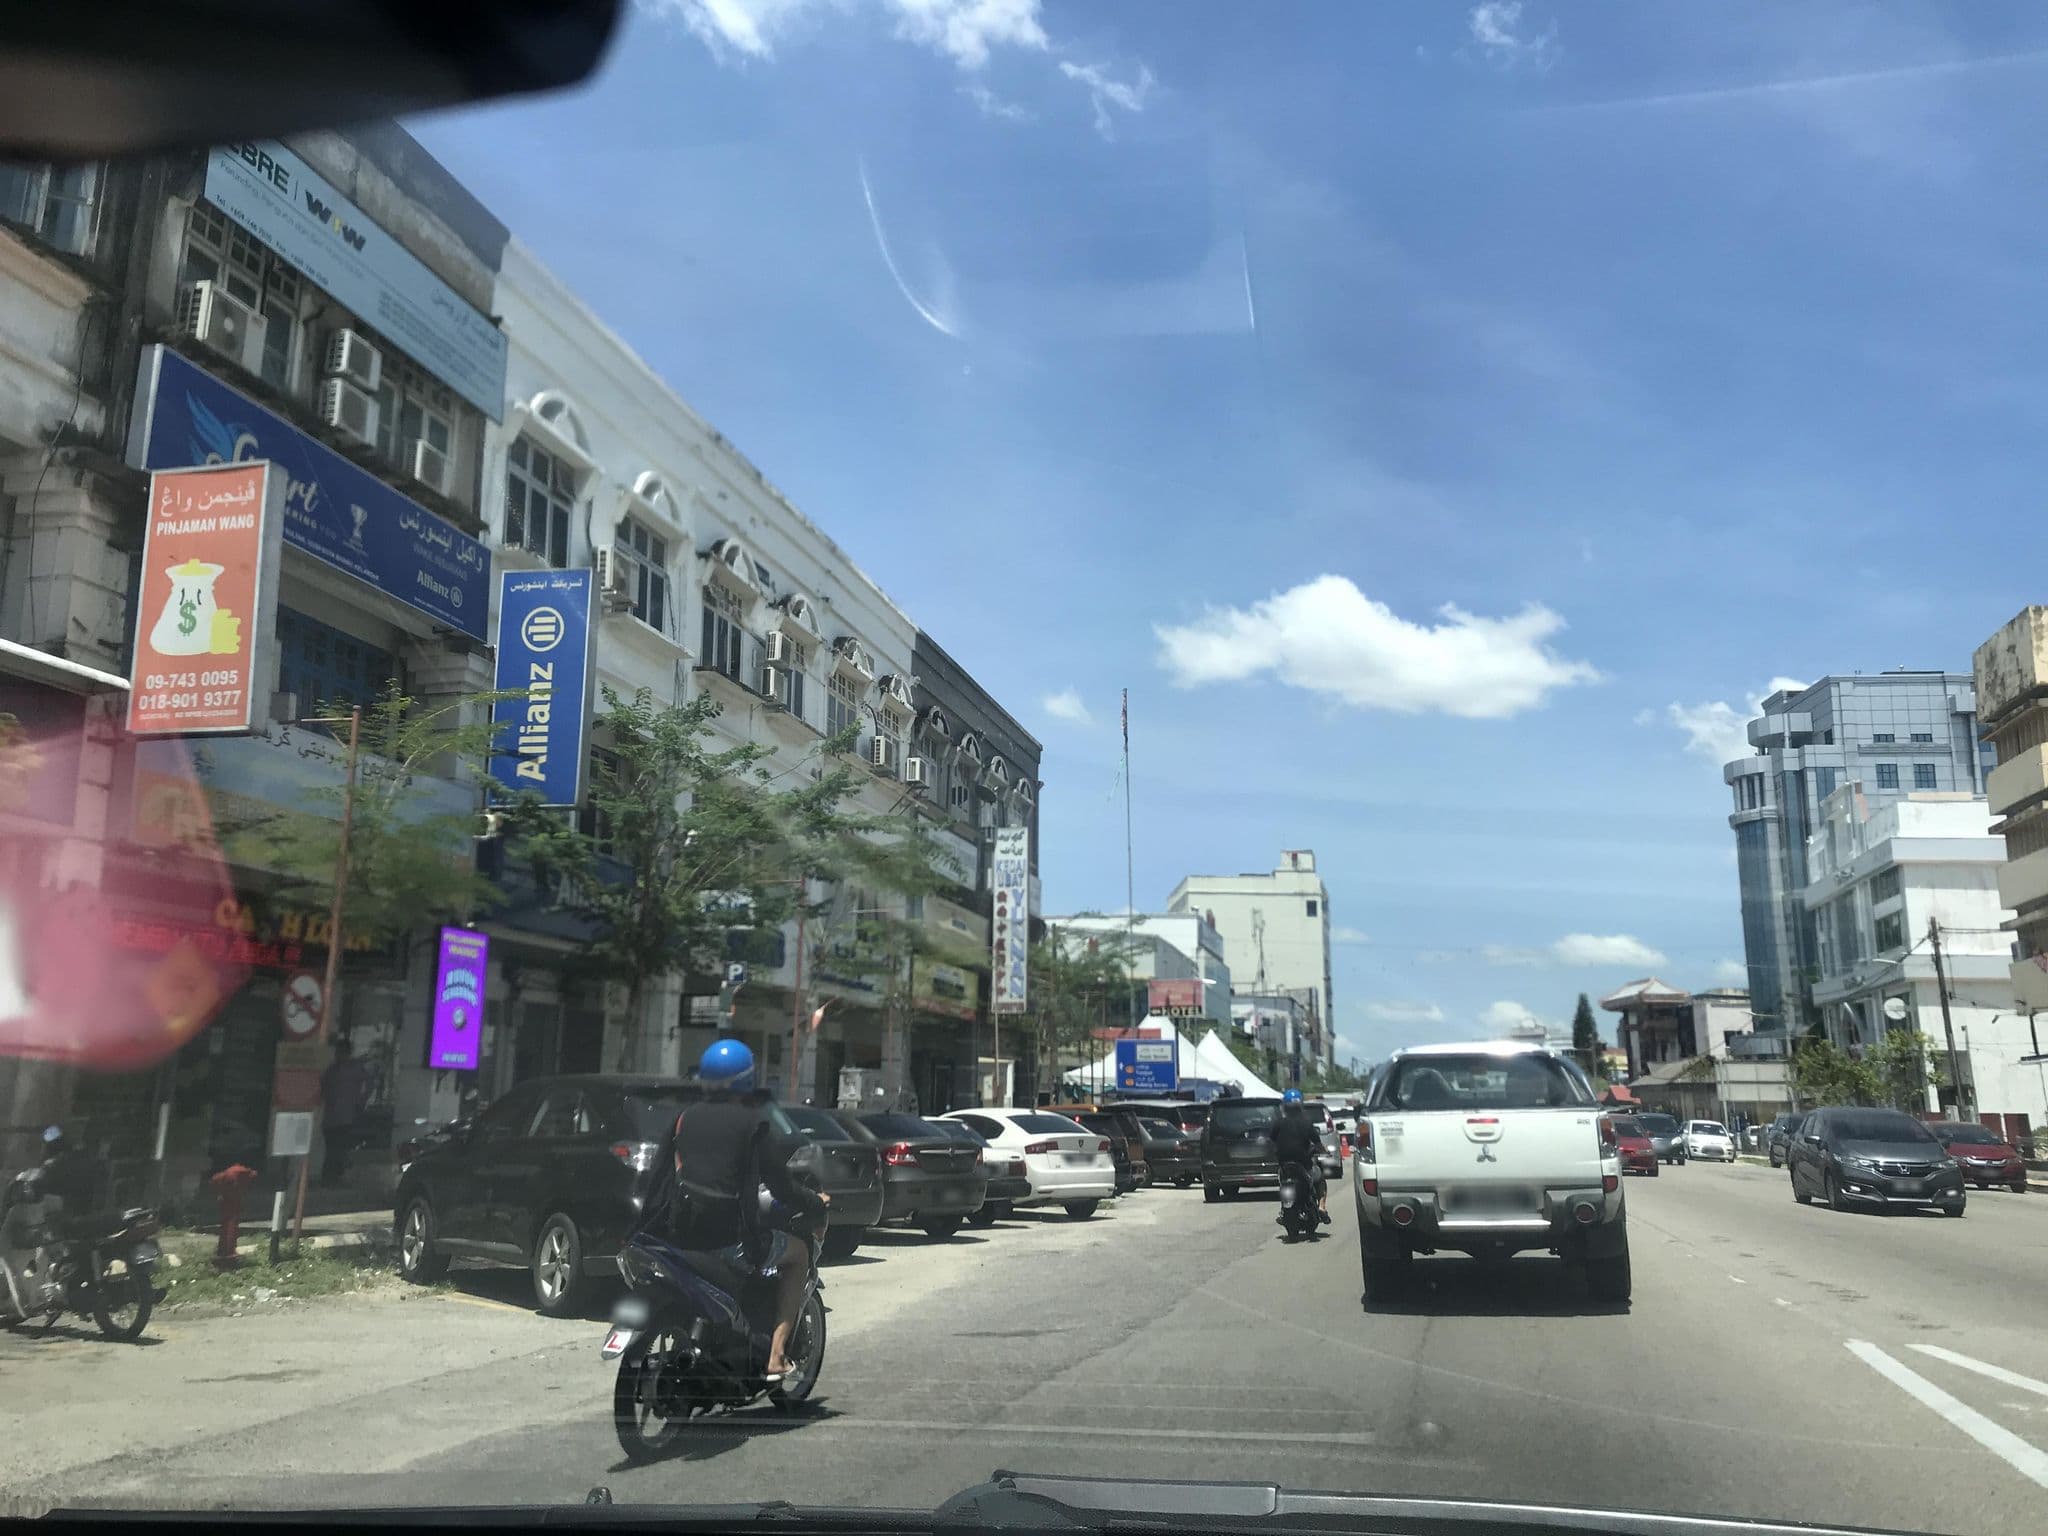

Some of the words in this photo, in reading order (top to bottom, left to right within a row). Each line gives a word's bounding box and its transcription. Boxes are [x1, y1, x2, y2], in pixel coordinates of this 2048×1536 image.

[156, 518, 216, 536] PINJAMAN
[219, 513, 255, 530] WANG
[417, 569, 449, 600] Allianz
[145, 672, 197, 689] 09-743
[201, 670, 238, 686] 0095
[138, 692, 198, 710] 018-901
[203, 690, 242, 706] 9377
[516, 661, 554, 783] Allianz
[728, 963, 743, 980] P
[1161, 1005, 1202, 1018] HOTEL
[607, 1332, 621, 1350] L
